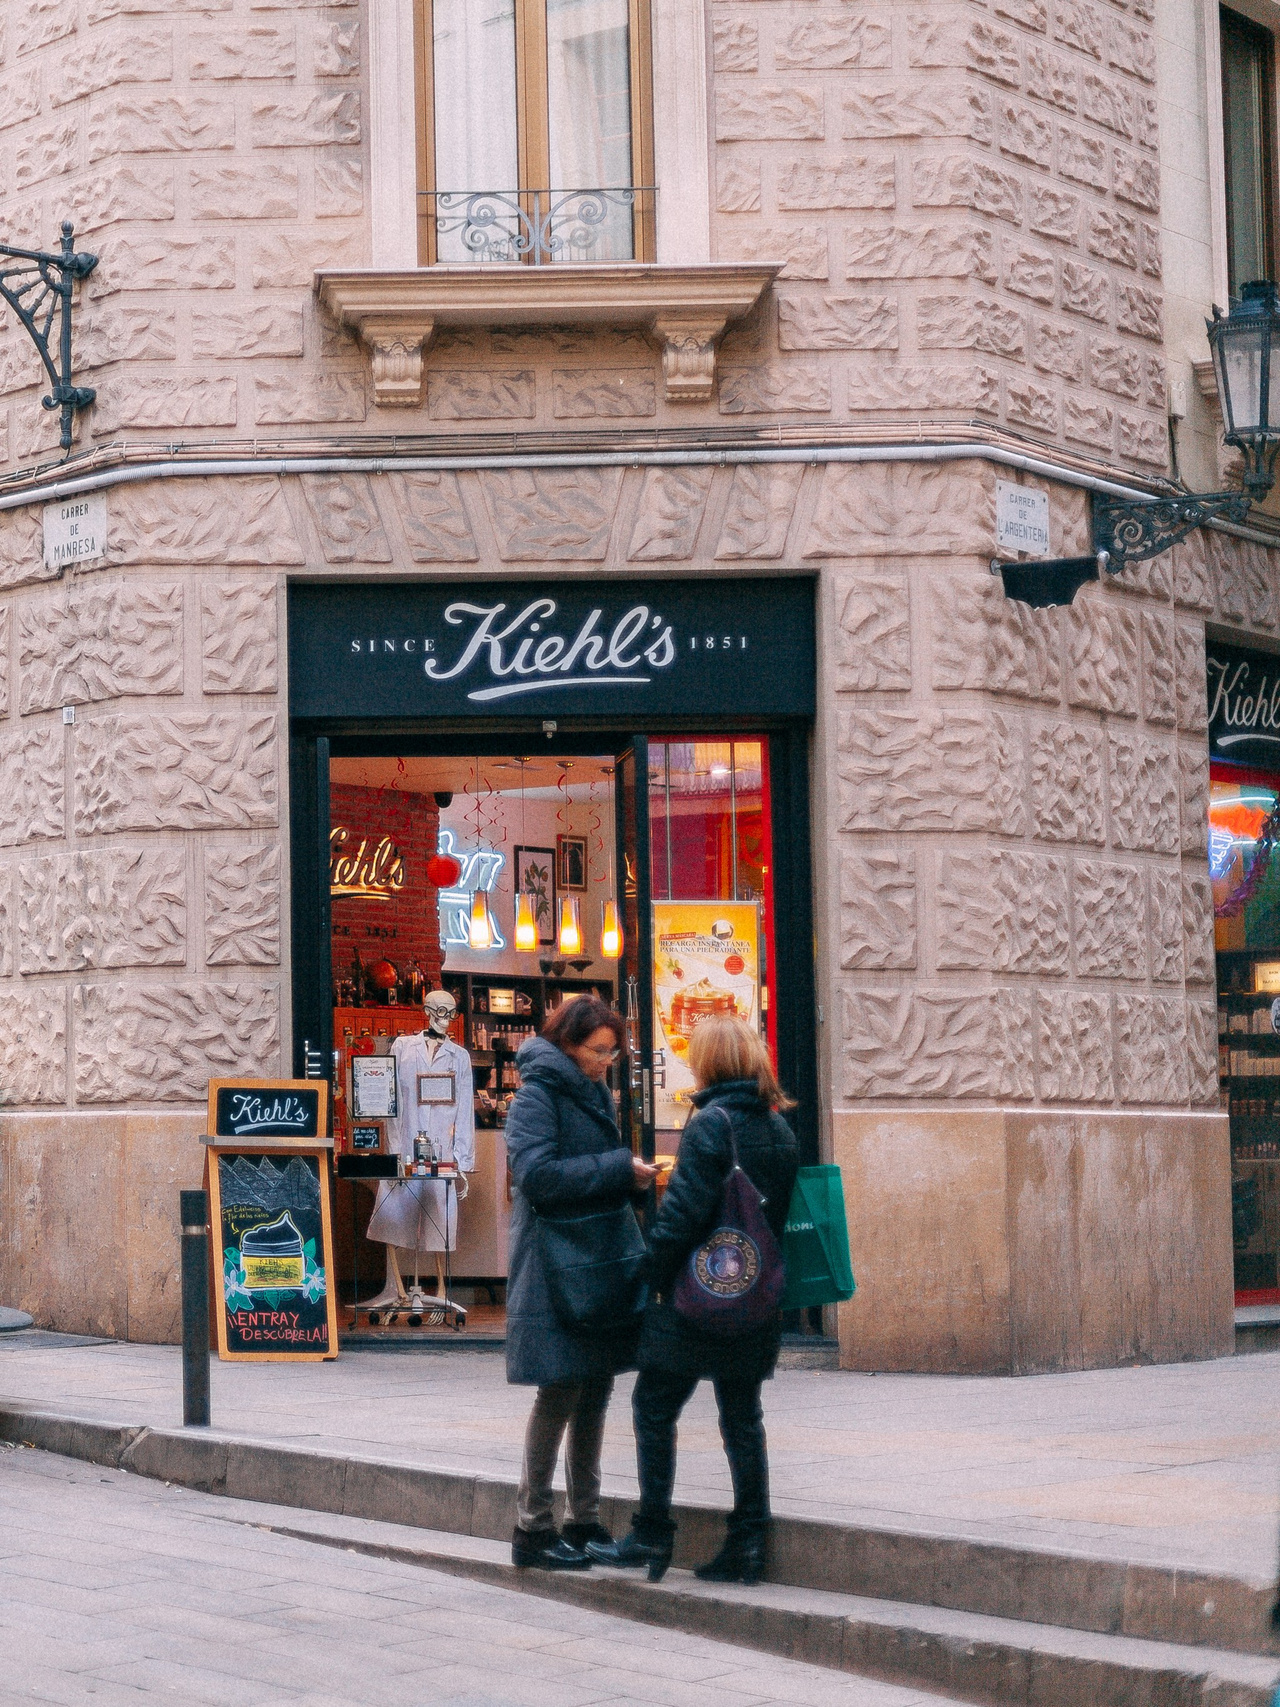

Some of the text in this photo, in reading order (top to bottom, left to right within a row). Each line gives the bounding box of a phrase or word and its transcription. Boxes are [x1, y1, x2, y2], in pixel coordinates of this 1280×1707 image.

[61, 503, 89, 520] CARRER
[1009, 493, 1036, 508] CARRER
[1018, 509, 1027, 520] DE
[70, 523, 79, 536] DE
[998, 518, 1048, 544] L'ARGENTERIA
[53, 536, 96, 561] MANRESA
[351, 598, 748, 680] SINCE Kiehl's 1851
[329, 826, 407, 887] iehl's
[230, 1094, 309, 1124] Kiehl's
[697, 1250, 710, 1284] TOUS
[741, 1241, 757, 1276] TOUS
[713, 1278, 748, 1293] TOUS
